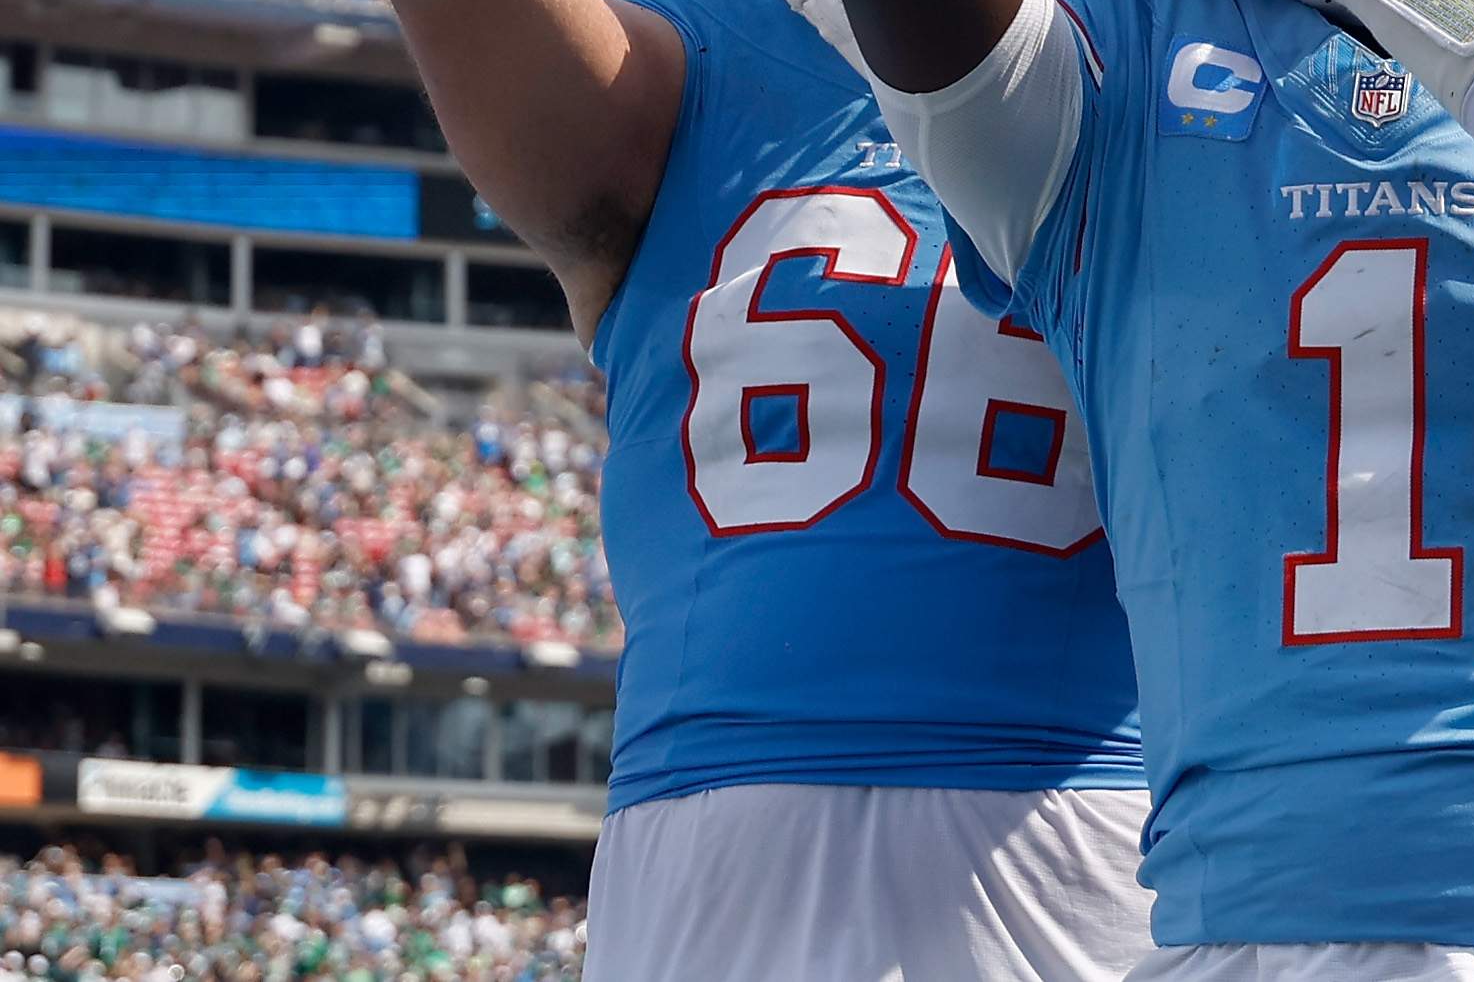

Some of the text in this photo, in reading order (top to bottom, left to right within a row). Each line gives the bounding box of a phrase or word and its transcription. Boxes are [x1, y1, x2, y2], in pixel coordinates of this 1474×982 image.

[1168, 42, 1262, 114] C
[1361, 89, 1398, 115] NFL
[1282, 238, 1463, 646] 1
